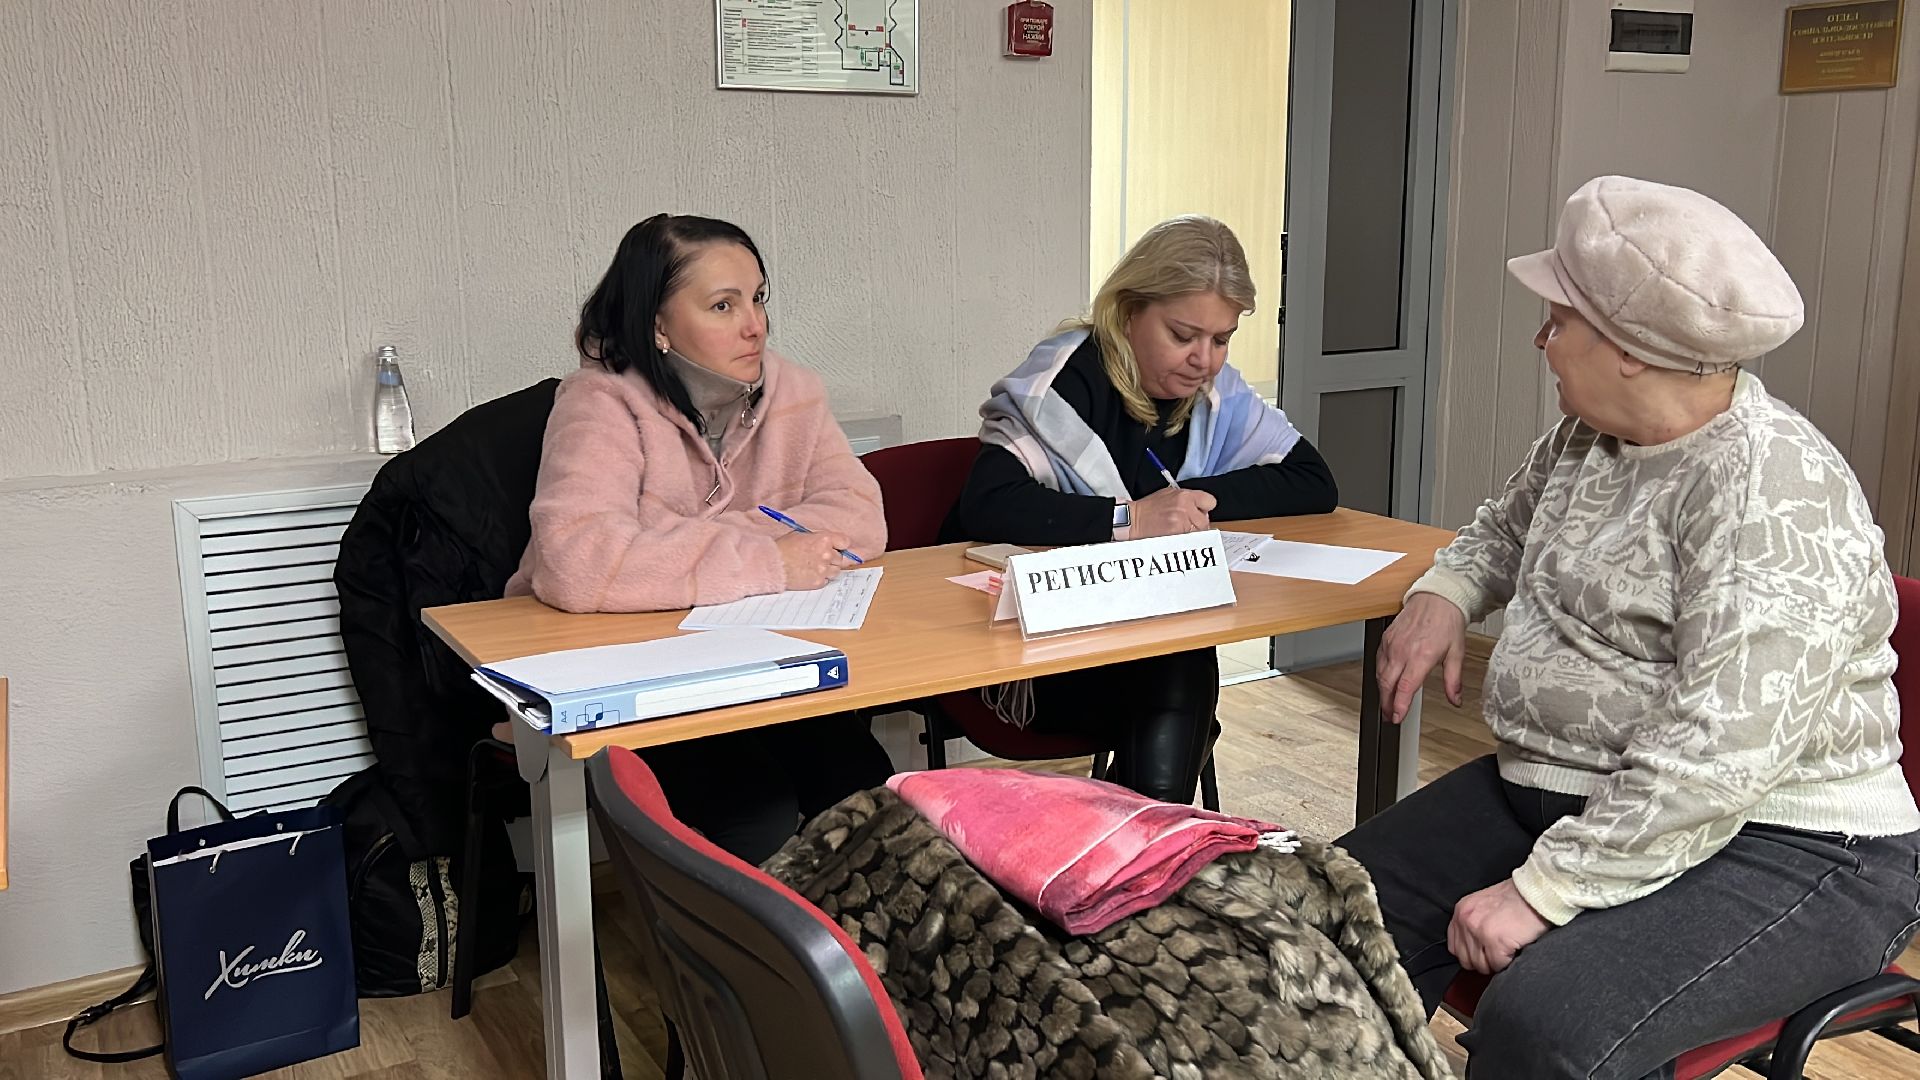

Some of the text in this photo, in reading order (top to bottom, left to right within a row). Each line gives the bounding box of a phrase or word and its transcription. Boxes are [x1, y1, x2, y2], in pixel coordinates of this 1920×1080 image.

[1027, 546, 1218, 594] РЕГИСТРАЦИЯ
[561, 710, 568, 723] A4
[204, 929, 323, 1001] Химки
